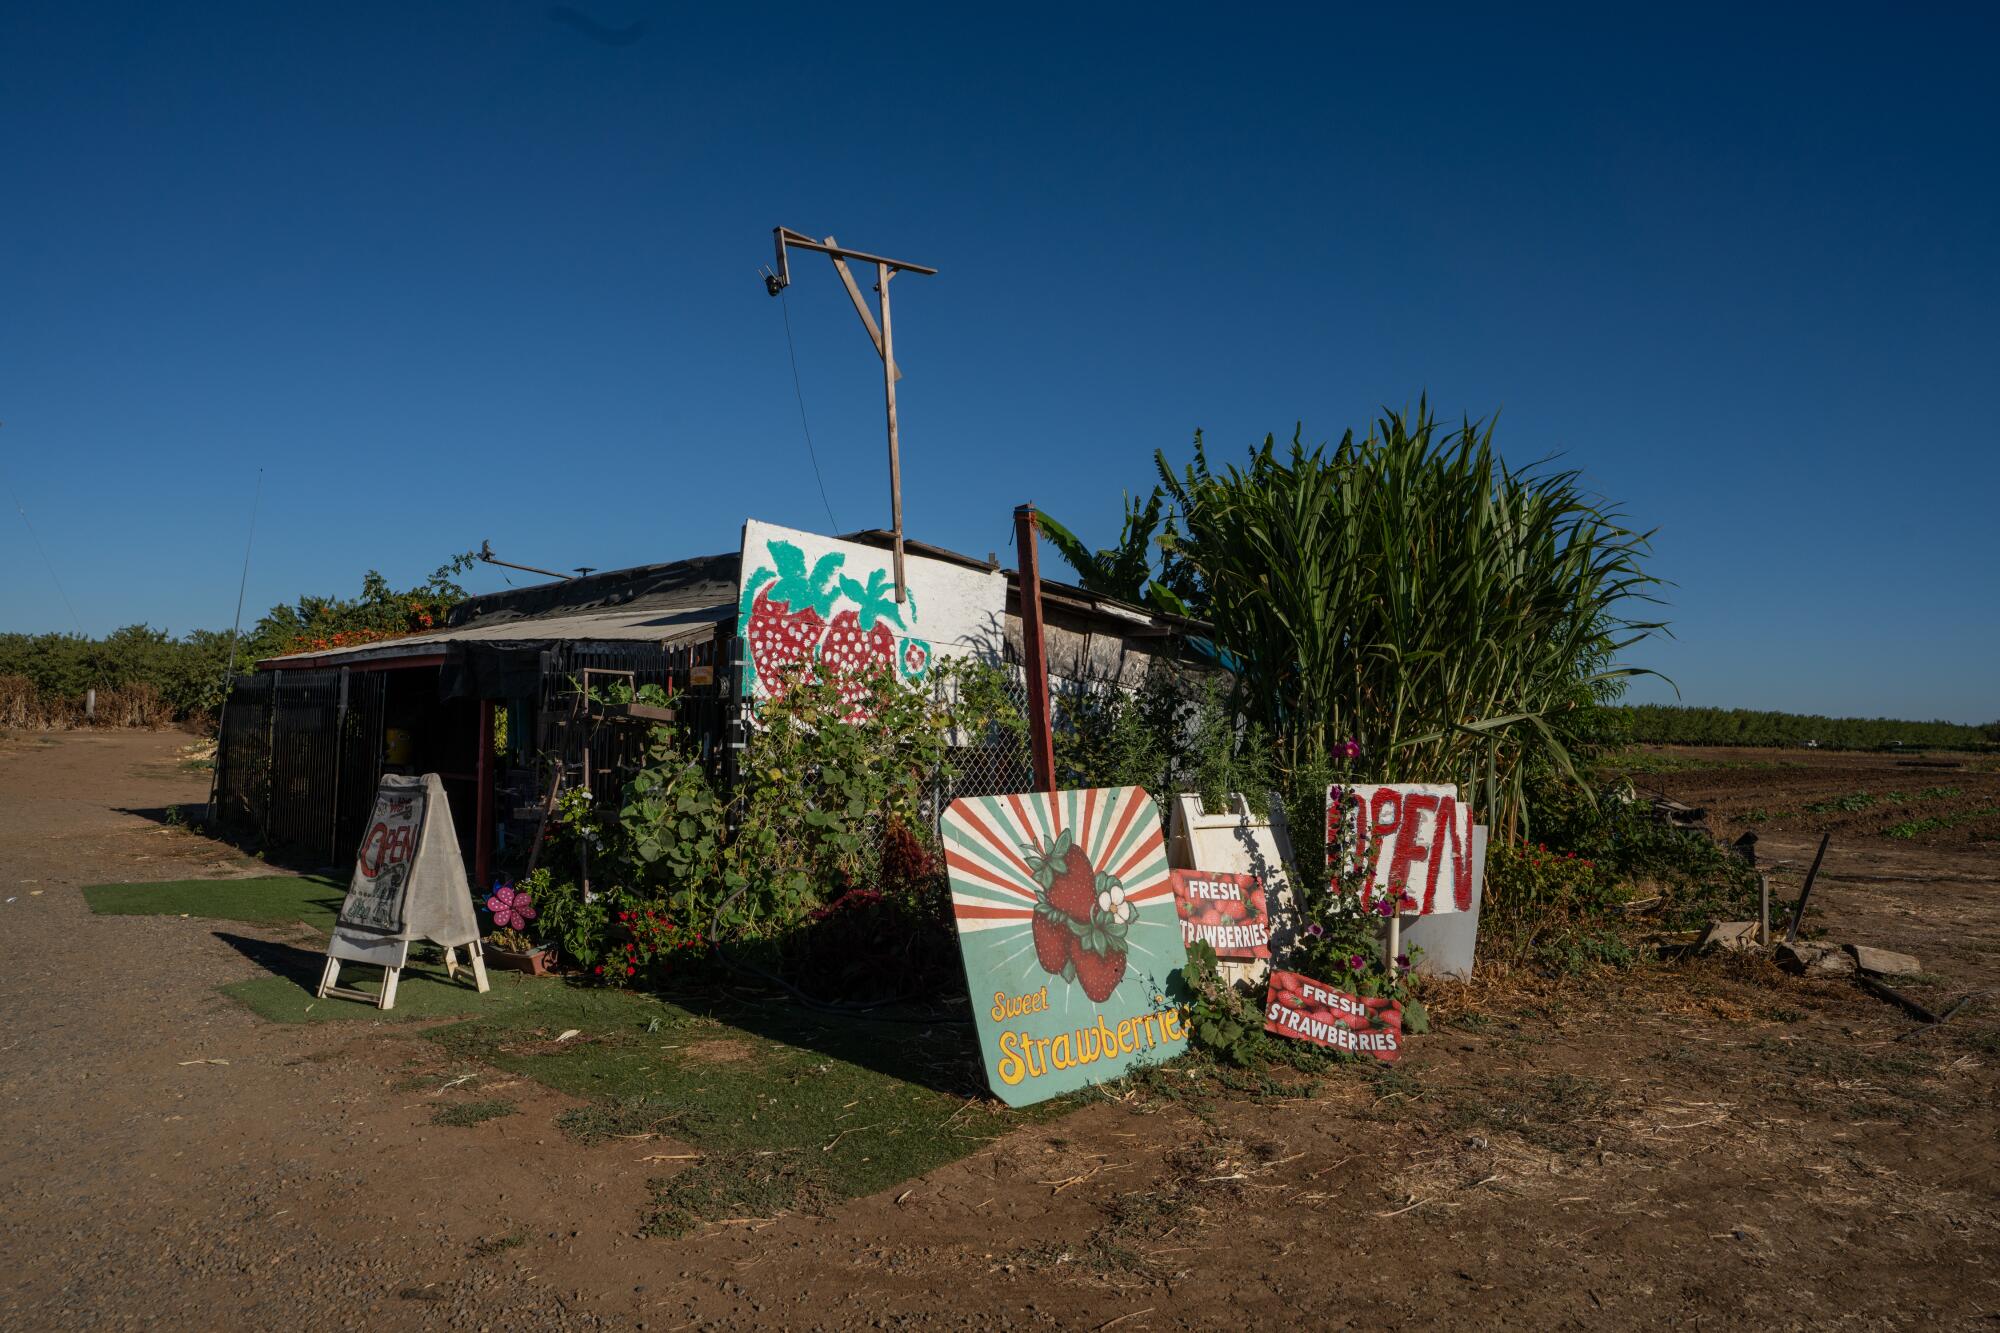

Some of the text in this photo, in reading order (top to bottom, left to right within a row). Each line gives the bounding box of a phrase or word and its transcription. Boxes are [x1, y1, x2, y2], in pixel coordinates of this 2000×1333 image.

[360, 822, 418, 878] OPEN
[1328, 787, 1473, 915] OPEN
[1188, 880, 1241, 900] FRESH
[1180, 919, 1268, 948] TRAWBERRIES
[991, 986, 1049, 1022] Sweet
[1303, 983, 1365, 1016] FRESH
[1268, 1003, 1397, 1051] STRAWBERRIES
